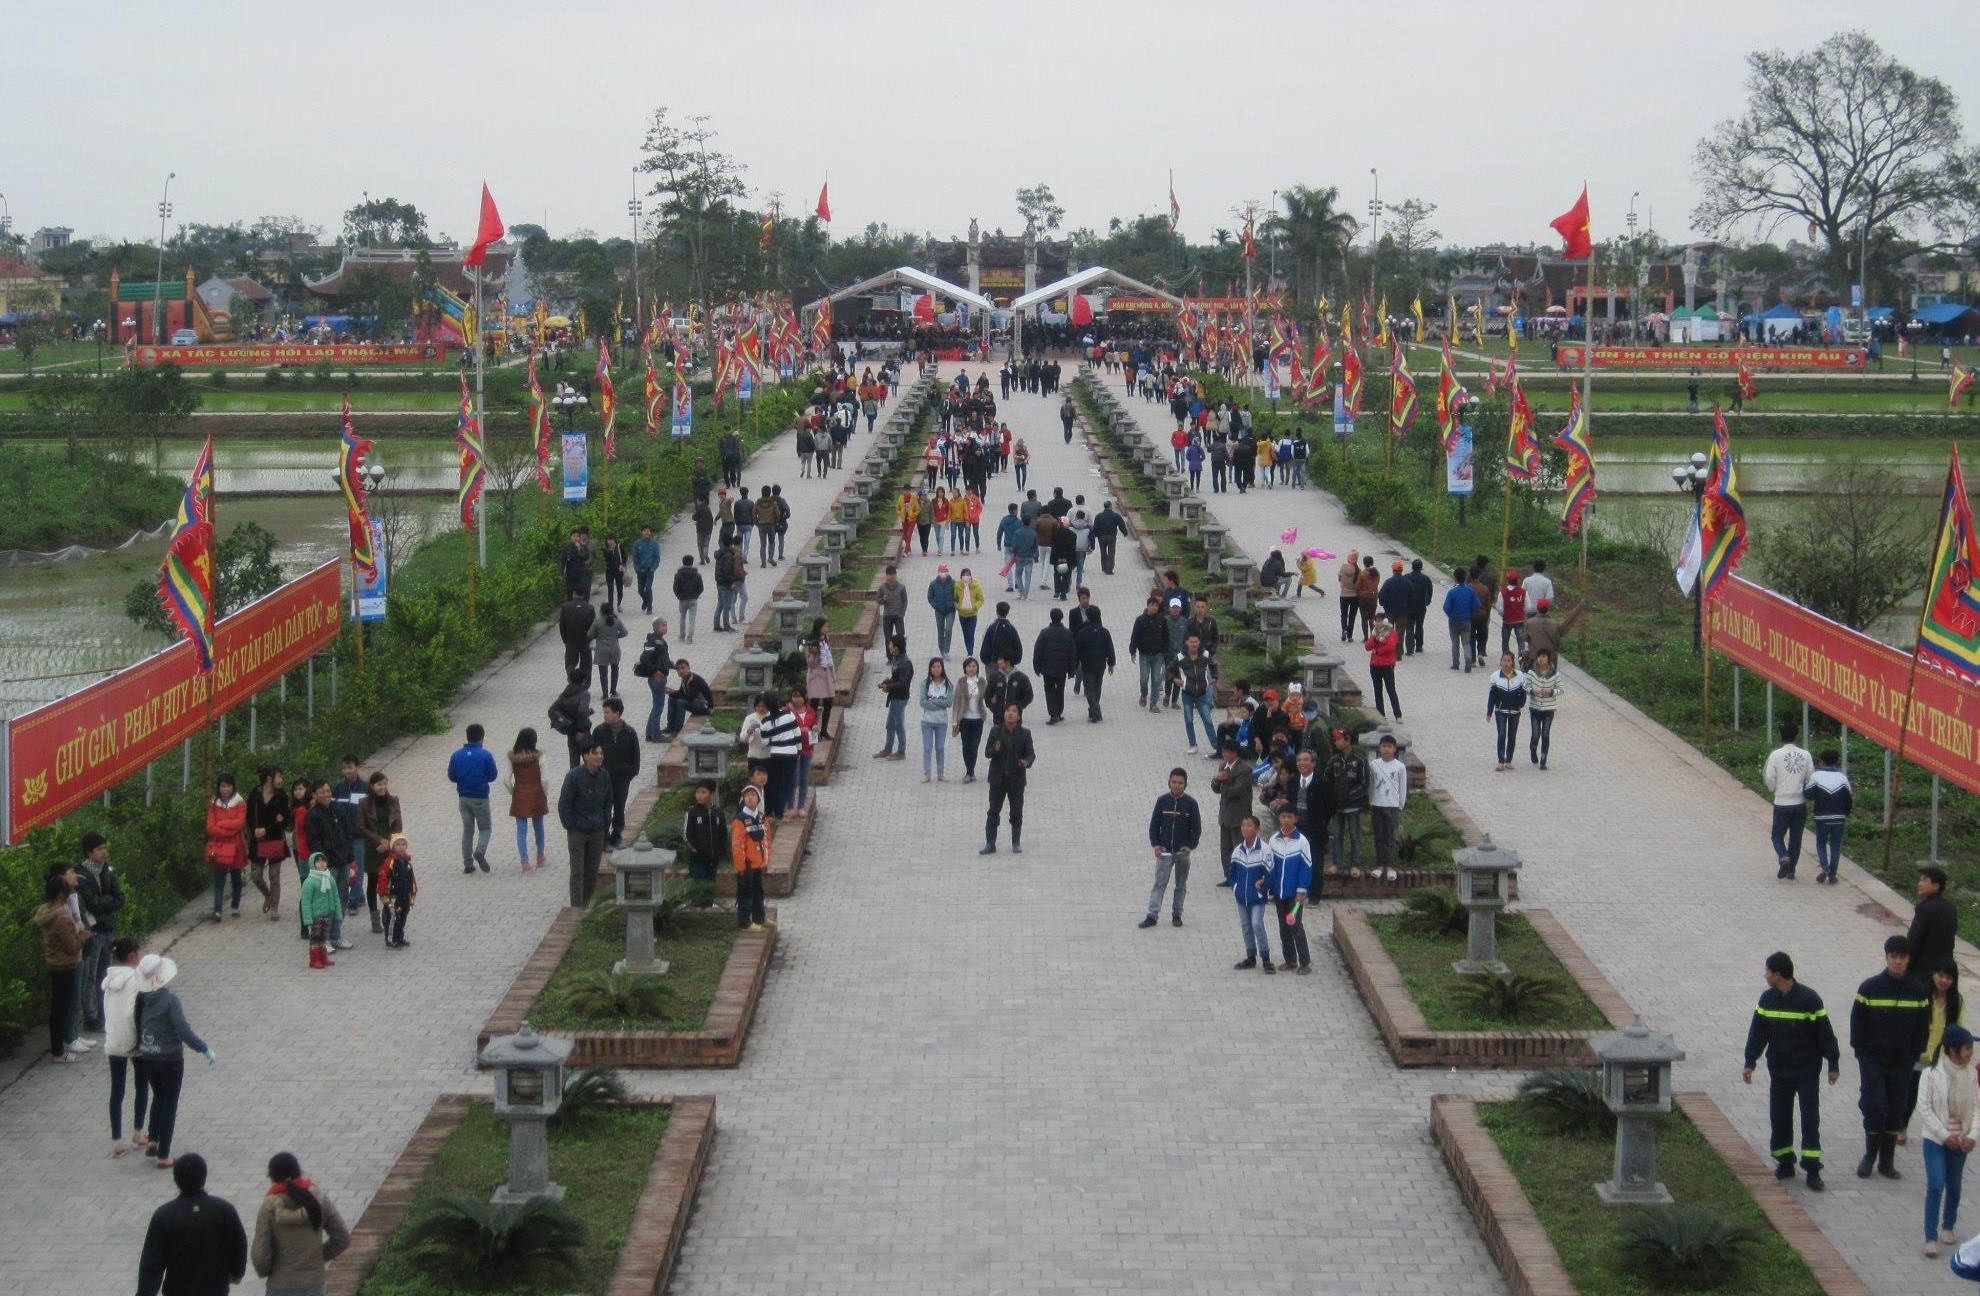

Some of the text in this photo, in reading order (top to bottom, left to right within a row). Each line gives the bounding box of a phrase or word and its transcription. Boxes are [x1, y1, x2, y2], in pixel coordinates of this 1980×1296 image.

[1780, 352, 1812, 360] KIM
[56, 724, 87, 785] GIỮ
[123, 688, 161, 749] PHÁT
[161, 679, 190, 727] HUY
[217, 633, 238, 691] SẮC
[241, 634, 261, 676] VĂN
[263, 619, 283, 662] HÓA
[285, 605, 305, 648] DÂN
[305, 594, 323, 639] TỘC
[1722, 602, 1741, 640] VĂN
[1742, 609, 1762, 652] HÓA
[1768, 628, 1783, 662] DU
[1784, 636, 1809, 679] LỊCH
[1811, 645, 1831, 694] HỘI
[1834, 659, 1867, 713] NHẬP
[1869, 673, 1887, 718] VÀ
[1928, 694, 1974, 760] TRIỂN
